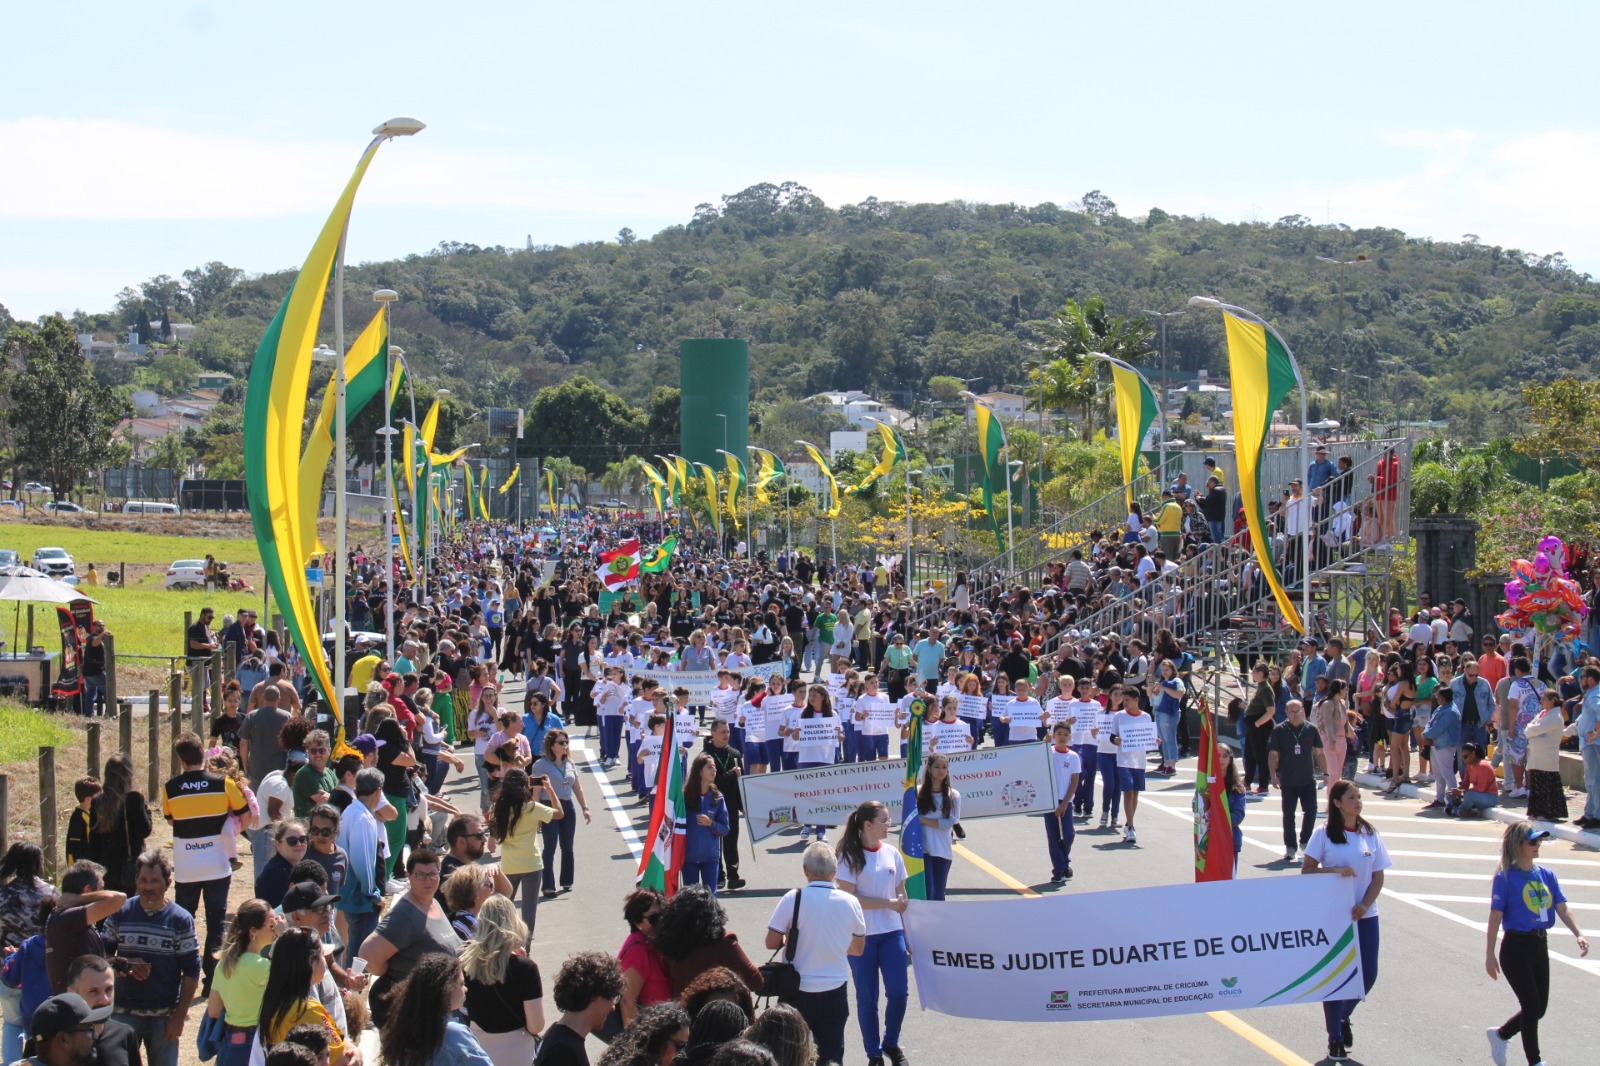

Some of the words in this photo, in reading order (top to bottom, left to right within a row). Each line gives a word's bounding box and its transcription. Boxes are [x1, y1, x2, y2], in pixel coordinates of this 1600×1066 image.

[794, 771, 832, 781] MOSTRA
[834, 763, 886, 776] CIENTÍFICA
[980, 752, 998, 761] 2023
[181, 780, 208, 790] ANJO
[794, 788, 835, 798] PROJETO
[837, 782, 890, 794] CIENTÍFICO
[953, 773, 983, 781] NOSSO
[815, 804, 858, 813] PESQUISA
[962, 790, 993, 799] CATIVO
[932, 950, 995, 970] EMEB
[1002, 950, 1084, 971] JUDITE
[1092, 941, 1188, 966] DUARTE
[1194, 937, 1224, 957] DE
[1231, 928, 1330, 954] OLIVEIRA
[1079, 988, 1123, 996] PREFEITURA
[1124, 985, 1162, 994] MUNICIPAL
[1175, 980, 1209, 989] CRICIÚMA
[1077, 1000, 1122, 1009] SECRETARIA
[1123, 997, 1161, 1006] MUNICIPAL
[1174, 992, 1213, 1002] EDUCAÇÃO
